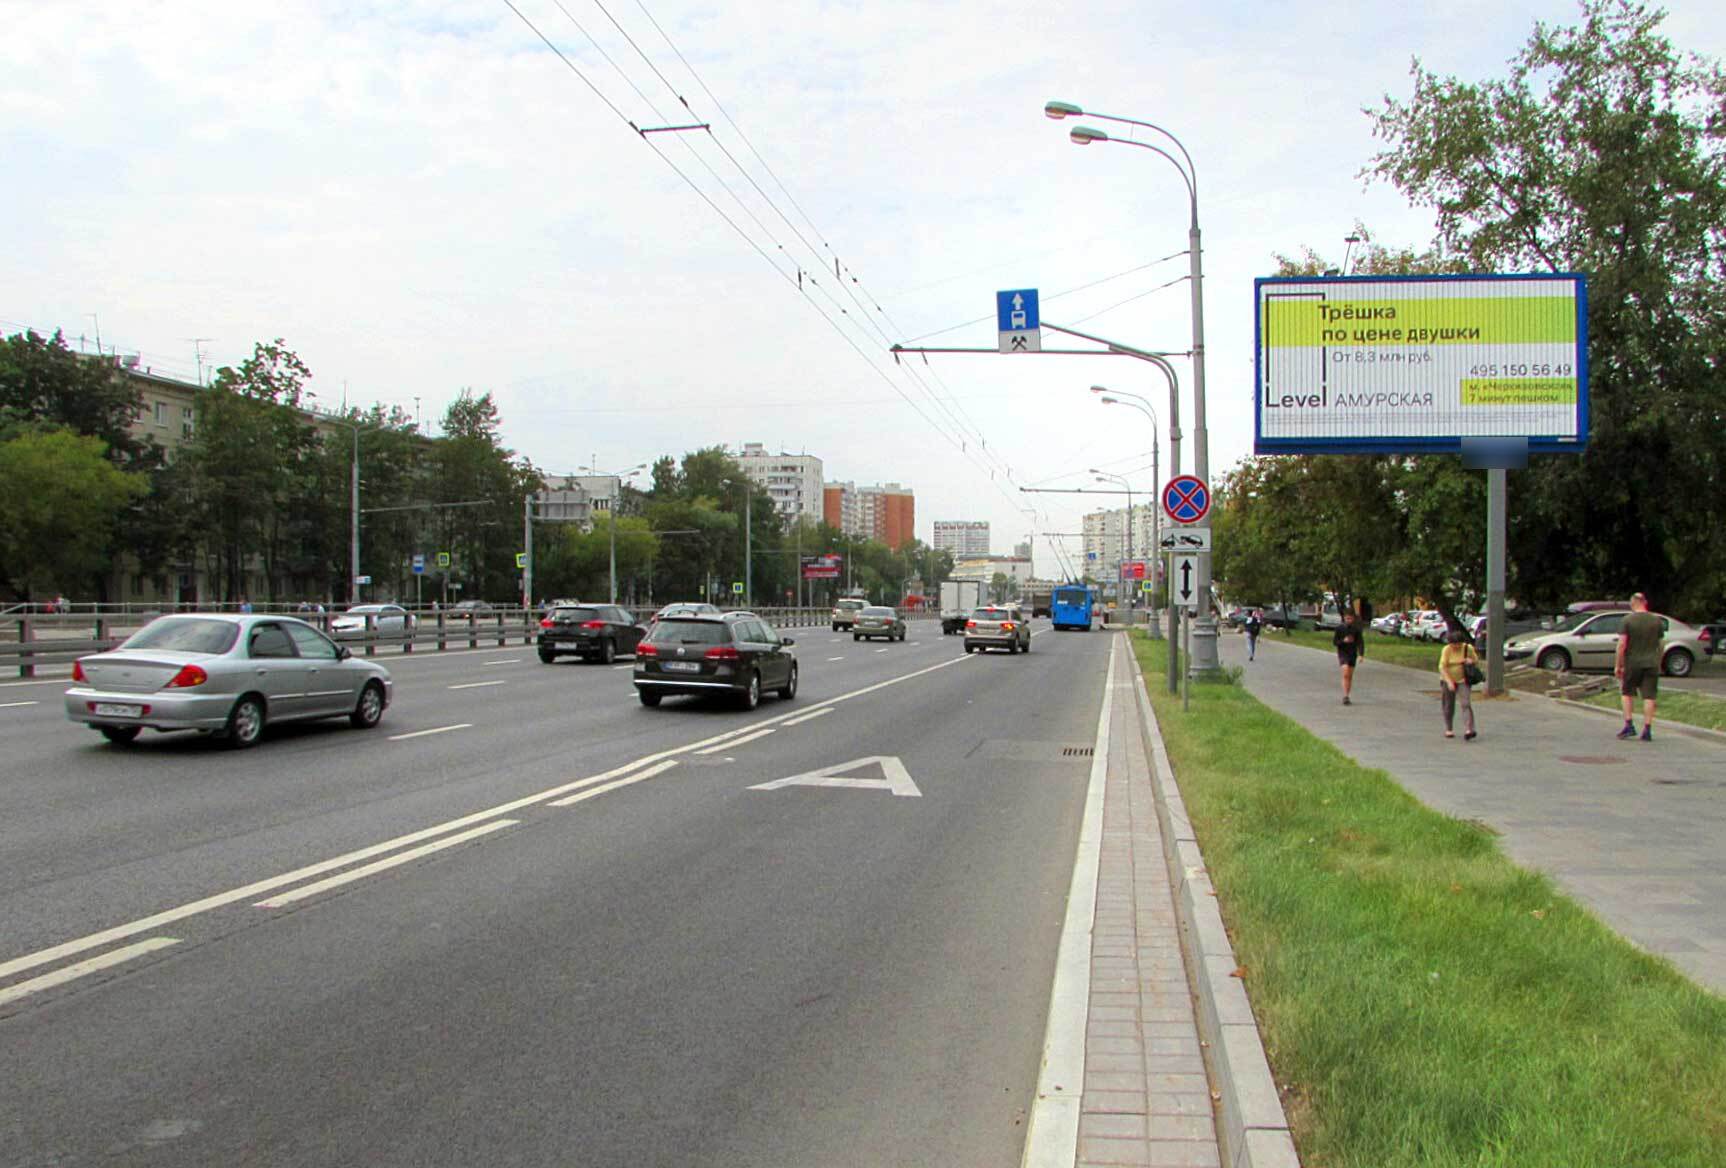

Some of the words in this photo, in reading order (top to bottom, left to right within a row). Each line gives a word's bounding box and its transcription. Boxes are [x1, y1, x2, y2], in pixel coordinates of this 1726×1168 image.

[1317, 304, 1396, 324] Трёшка
[1322, 329, 1347, 342] по
[1354, 328, 1402, 344] цене
[1407, 327, 1480, 344] двушки
[1332, 351, 1351, 363] От
[1380, 352, 1406, 362] млн
[1470, 364, 1498, 377] 495
[1503, 364, 1528, 377] 150
[1532, 364, 1551, 377] 56
[1554, 364, 1572, 377] 49
[1265, 385, 1327, 408] Level
[1335, 392, 1433, 407] АМУРСКАЯ
